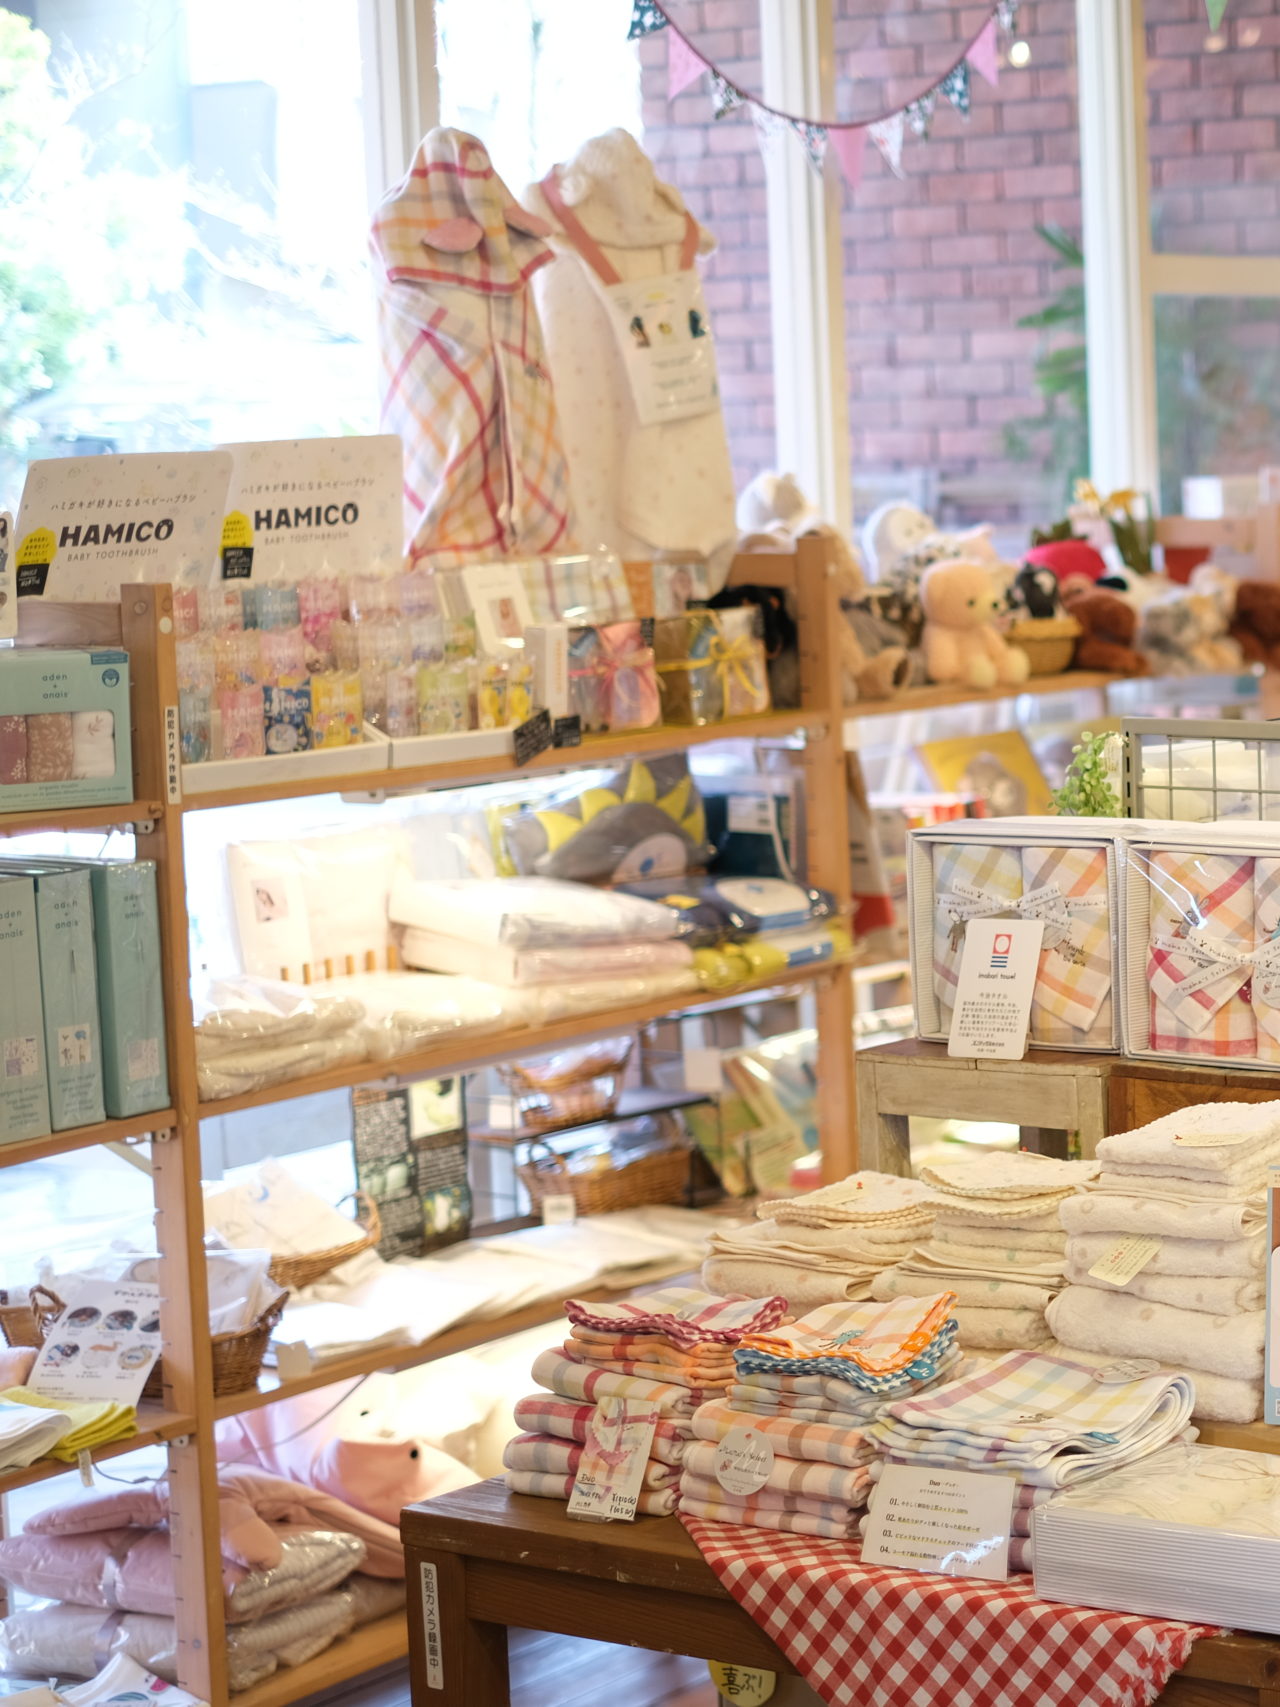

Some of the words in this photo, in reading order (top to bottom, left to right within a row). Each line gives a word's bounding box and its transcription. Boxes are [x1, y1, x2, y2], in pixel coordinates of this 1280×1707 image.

[254, 502, 359, 531] HAMICO
[59, 518, 174, 548] HAMICO
[67, 552, 91, 562] BABY
[95, 547, 159, 560] TOOTHBRUSH
[42, 673, 68, 682] aden
[42, 692, 69, 700] anais
[929, 1479, 941, 1487] Duo
[889, 1498, 900, 1506] 01.
[886, 1513, 896, 1522] 02.
[882, 1529, 893, 1538] 03.
[880, 1545, 891, 1554] 04.
[423, 1566, 439, 1669] 防犯カメラ録画中
